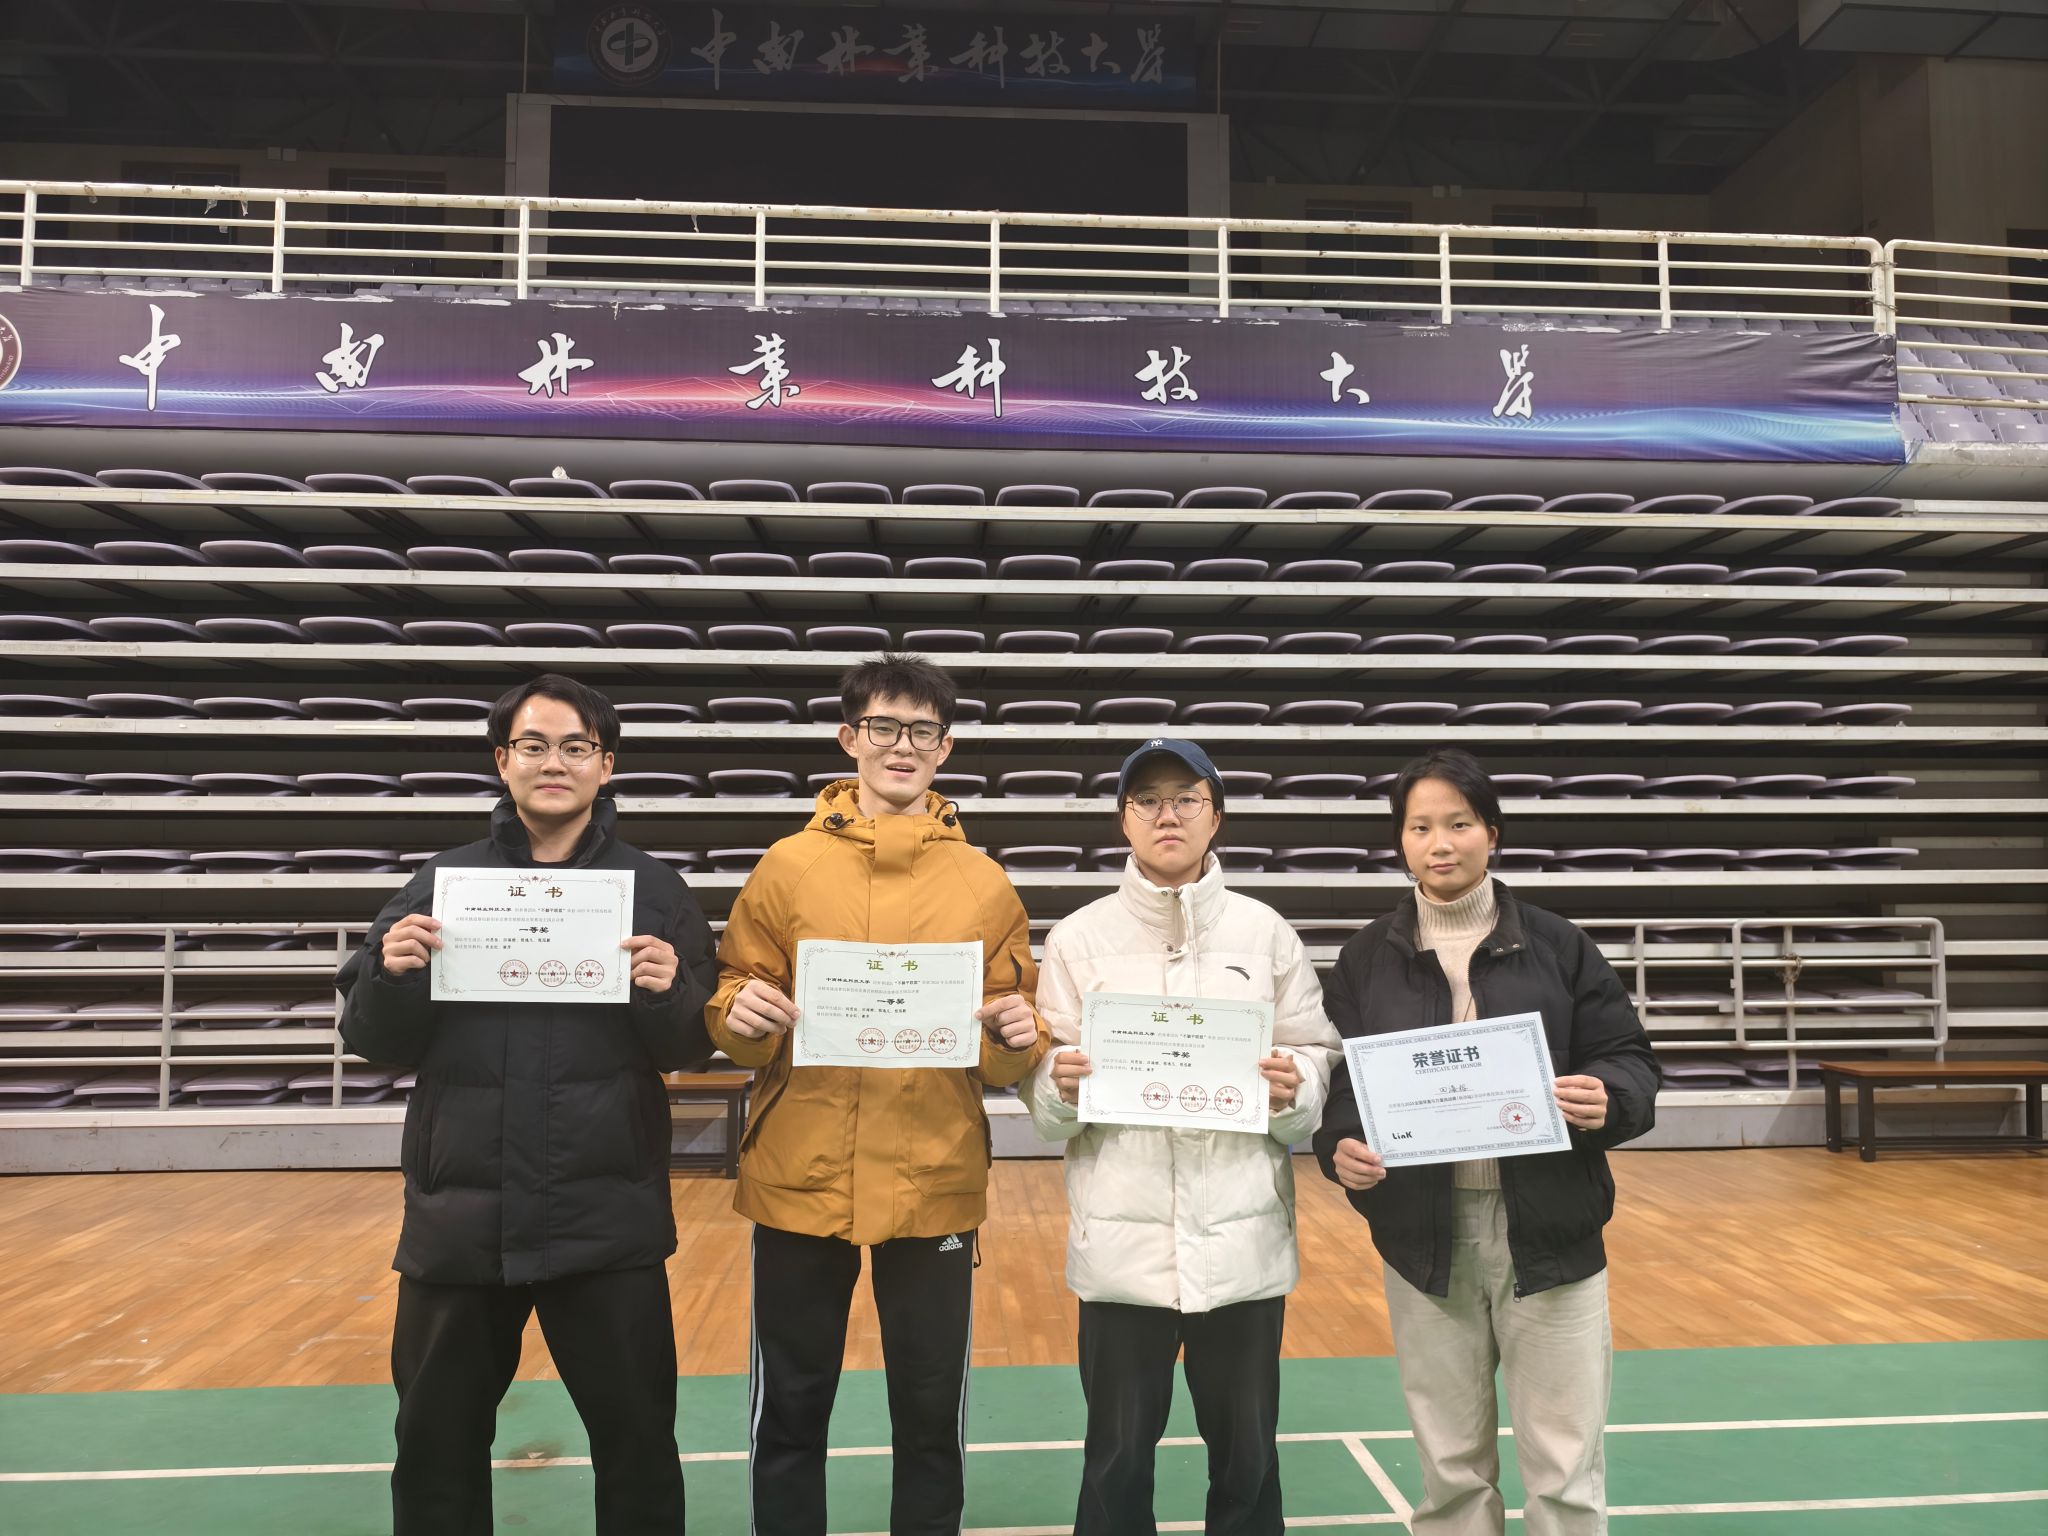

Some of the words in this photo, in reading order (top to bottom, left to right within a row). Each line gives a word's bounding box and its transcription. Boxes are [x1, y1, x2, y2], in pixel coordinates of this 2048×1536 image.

[507, 885, 563, 899] 证书
[518, 926, 550, 934] 一等奖
[866, 959, 919, 972] 证书
[876, 997, 906, 1005] 一等奖
[1151, 1011, 1205, 1026] 证书
[1161, 1050, 1191, 1059] 一等奖
[1412, 1045, 1480, 1068] 荣誉证书
[1415, 1066, 1451, 1075] CERTIFICATE
[939, 1242, 963, 1252] adidas
